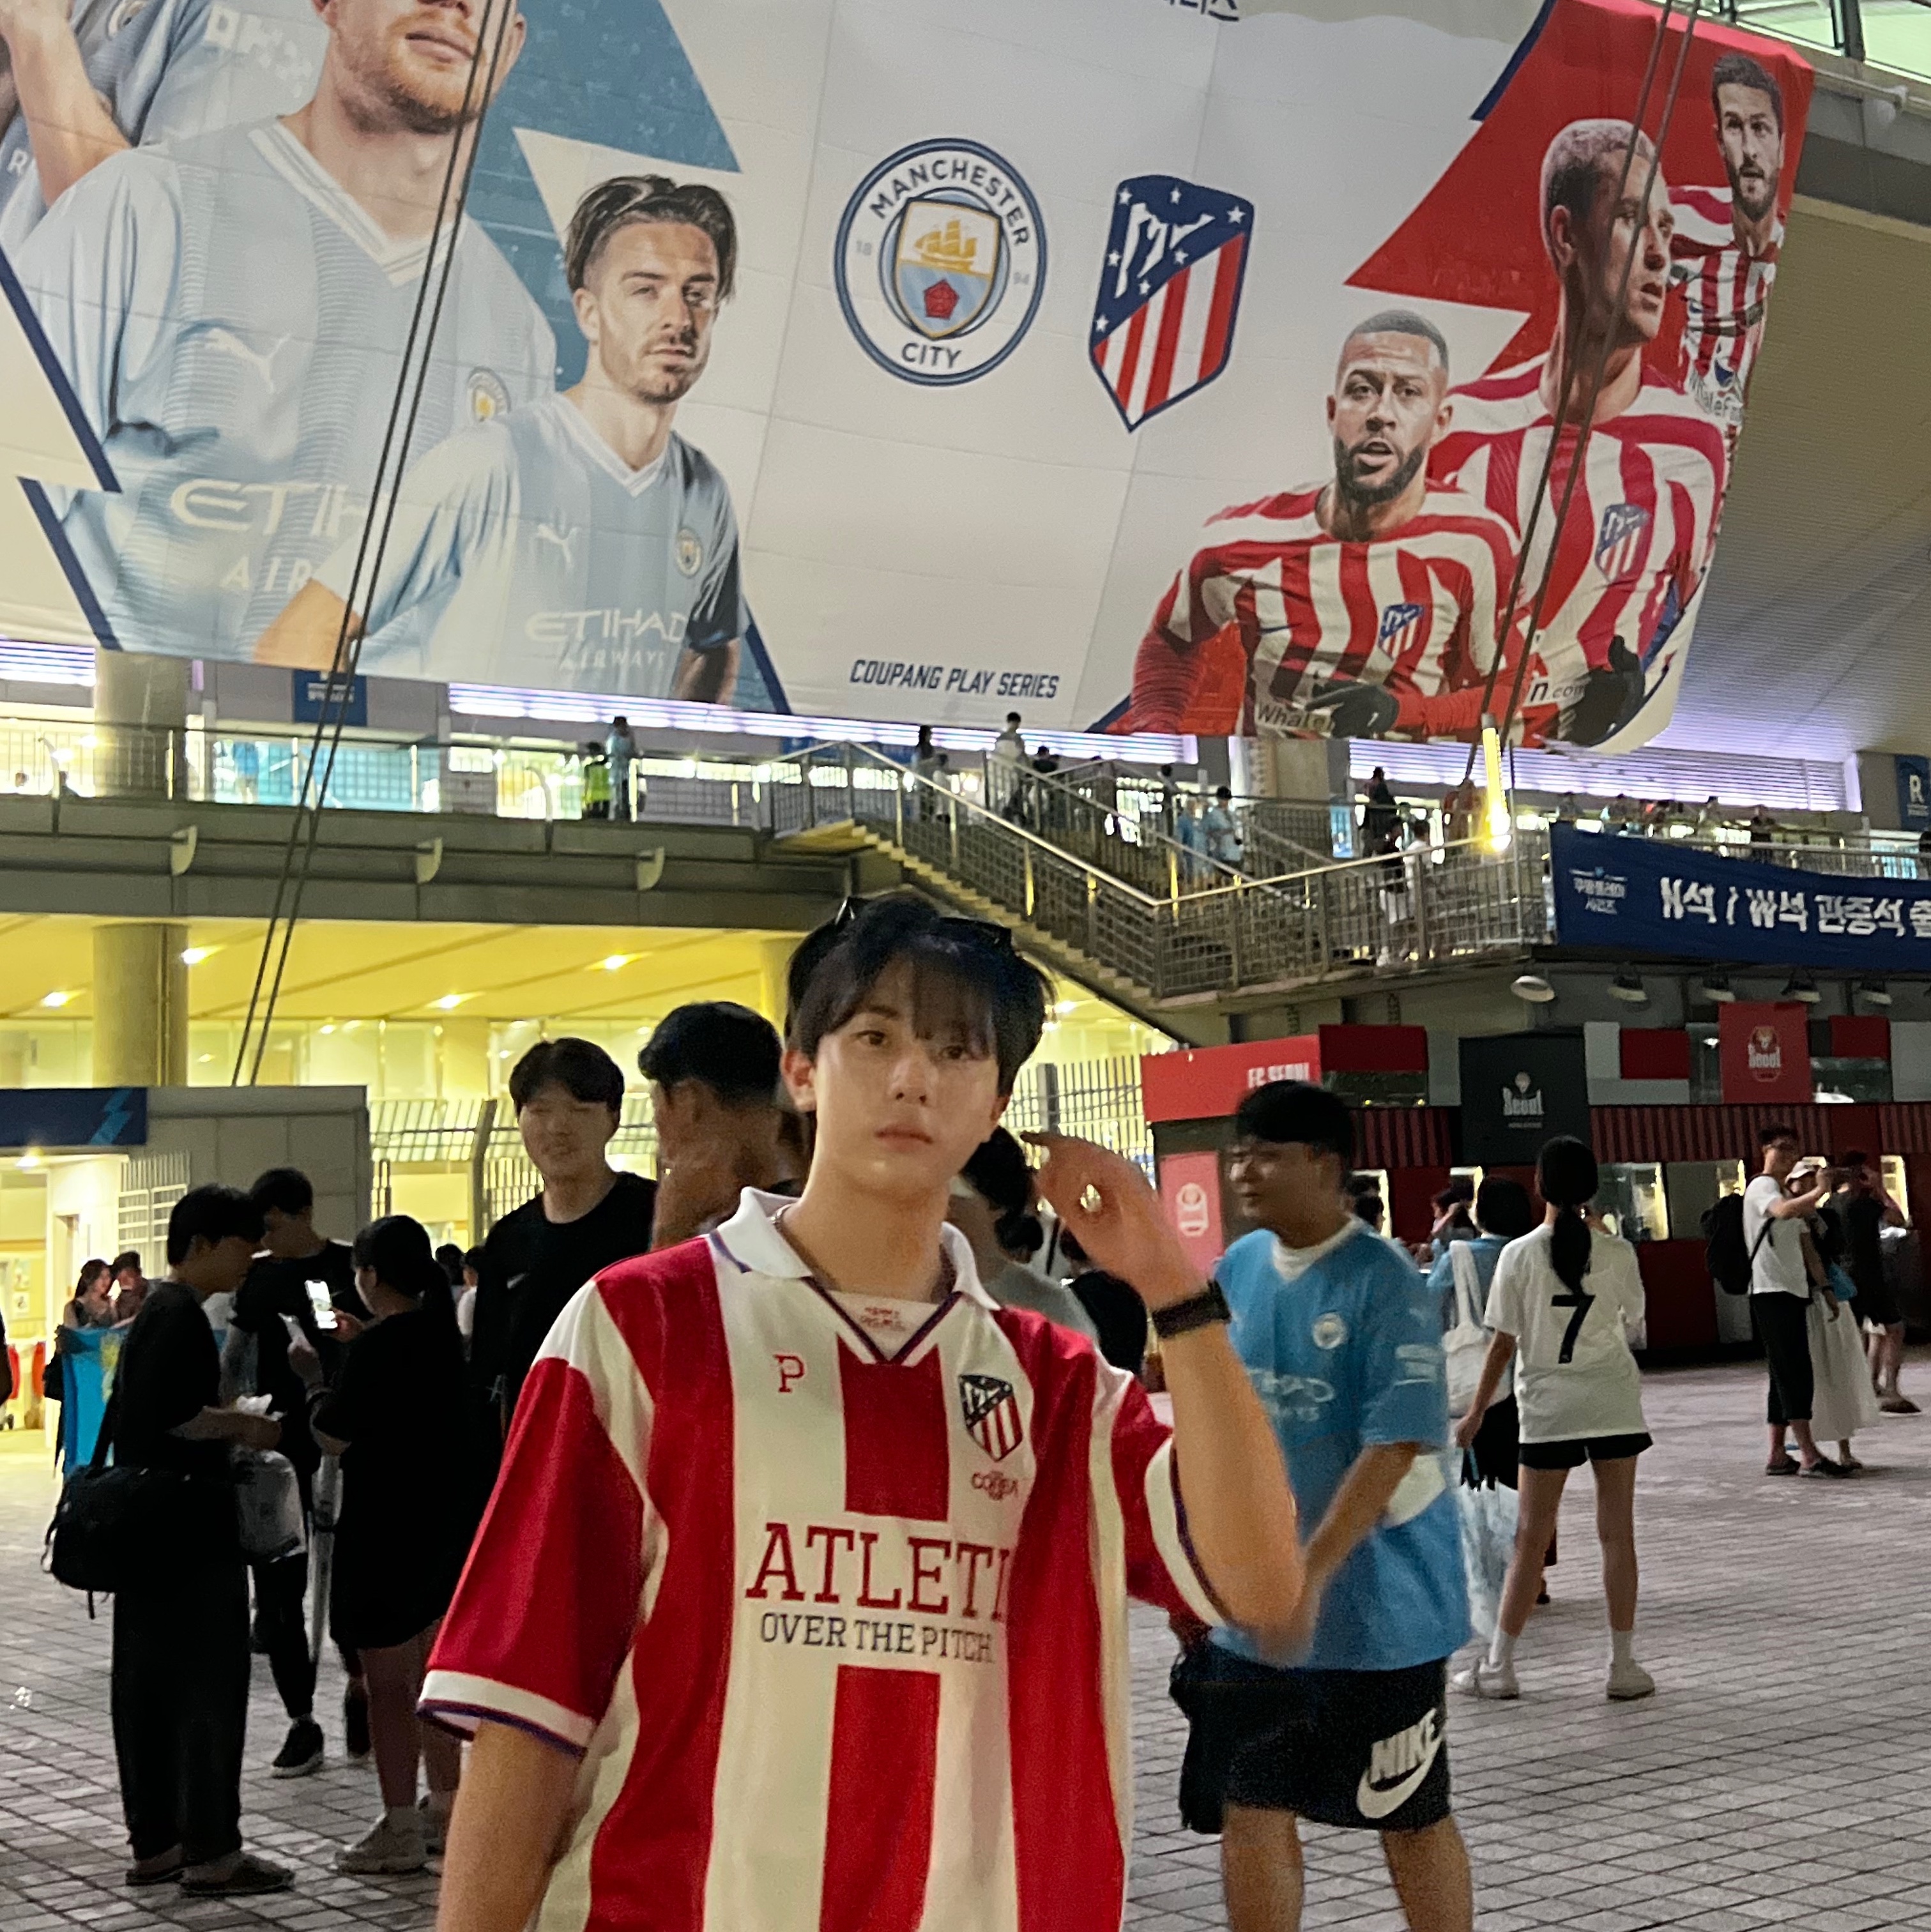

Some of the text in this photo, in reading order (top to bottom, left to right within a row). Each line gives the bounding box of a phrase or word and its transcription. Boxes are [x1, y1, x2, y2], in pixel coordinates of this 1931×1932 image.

[869, 159, 1030, 247] MANCHESTER
[901, 342, 962, 369] CITY
[524, 608, 689, 643] ETIHAD
[850, 660, 1060, 699] COUPANG PLAY SERIES
[1661, 876, 1718, 924] N석
[1813, 894, 1907, 938] 관중석
[1551, 1294, 1596, 1364] 7
[773, 1354, 805, 1393] P
[745, 1522, 1011, 1623] ATLETI
[761, 1612, 995, 1662] OVER THE PITCH
[1370, 1708, 1436, 1785] NIKE
